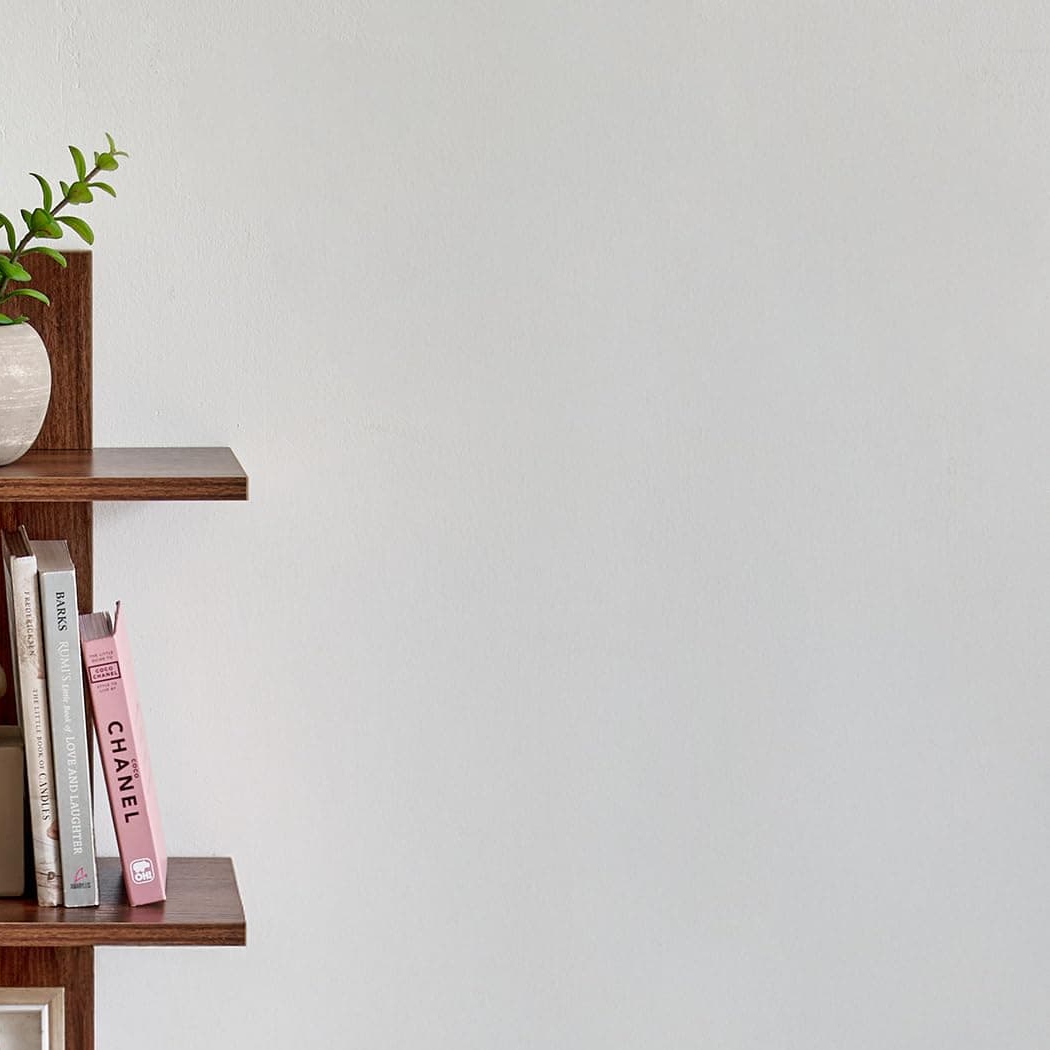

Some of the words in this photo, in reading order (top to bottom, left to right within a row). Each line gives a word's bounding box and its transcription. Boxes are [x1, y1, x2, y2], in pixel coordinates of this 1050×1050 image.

[55, 591, 68, 632] BARKS
[56, 641, 71, 681] RUMI'S
[93, 671, 118, 679] CHANEL
[33, 706, 42, 733] LITTLE
[36, 736, 44, 758] BOOK
[65, 736, 77, 766] LOVE
[38, 760, 45, 769] OF
[107, 721, 140, 824] CHANEL
[131, 758, 139, 779] COCO
[67, 767, 79, 793] AND
[38, 772, 51, 821] CANDLES
[69, 795, 84, 855] LAUGHTER
